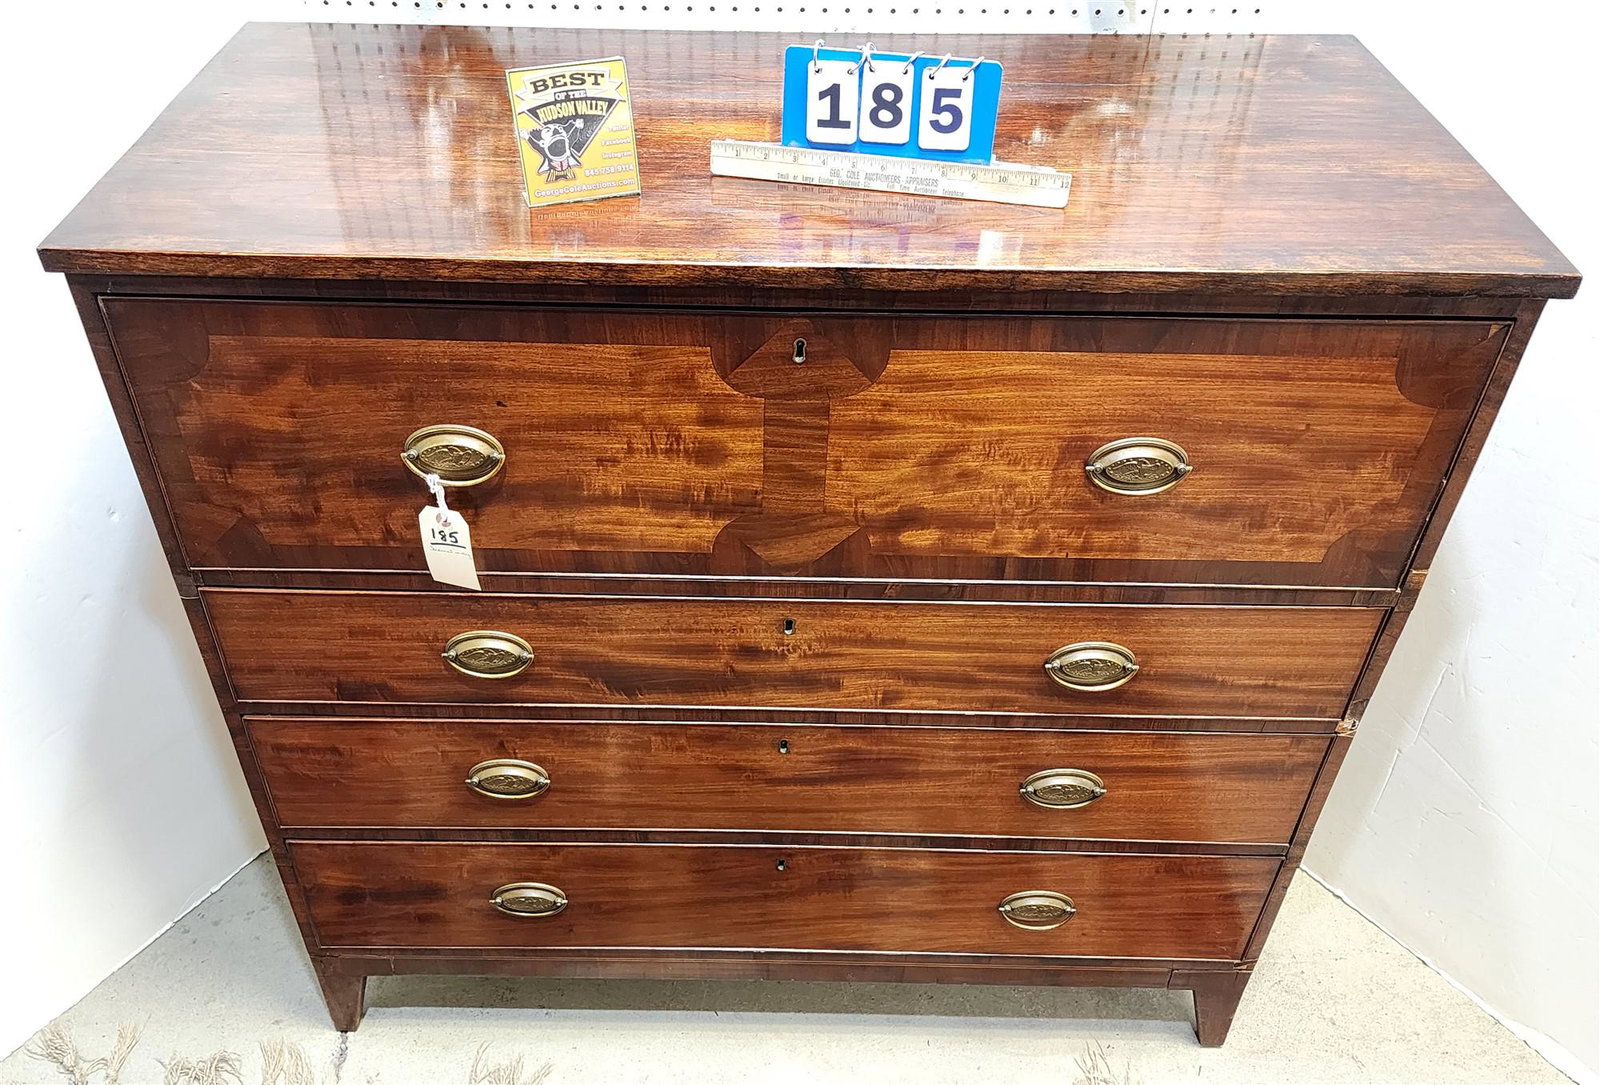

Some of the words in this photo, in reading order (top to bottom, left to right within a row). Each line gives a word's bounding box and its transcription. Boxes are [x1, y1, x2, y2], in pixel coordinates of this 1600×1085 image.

[530, 72, 604, 94] BEST
[555, 92, 566, 100] OF
[570, 90, 587, 99] THE
[536, 101, 575, 122] HUDSON
[575, 100, 609, 115] VALLEY
[846, 170, 860, 180] COLE
[535, 179, 636, 197] GeorgeColeAuctions.com
[431, 528, 459, 544] 185
